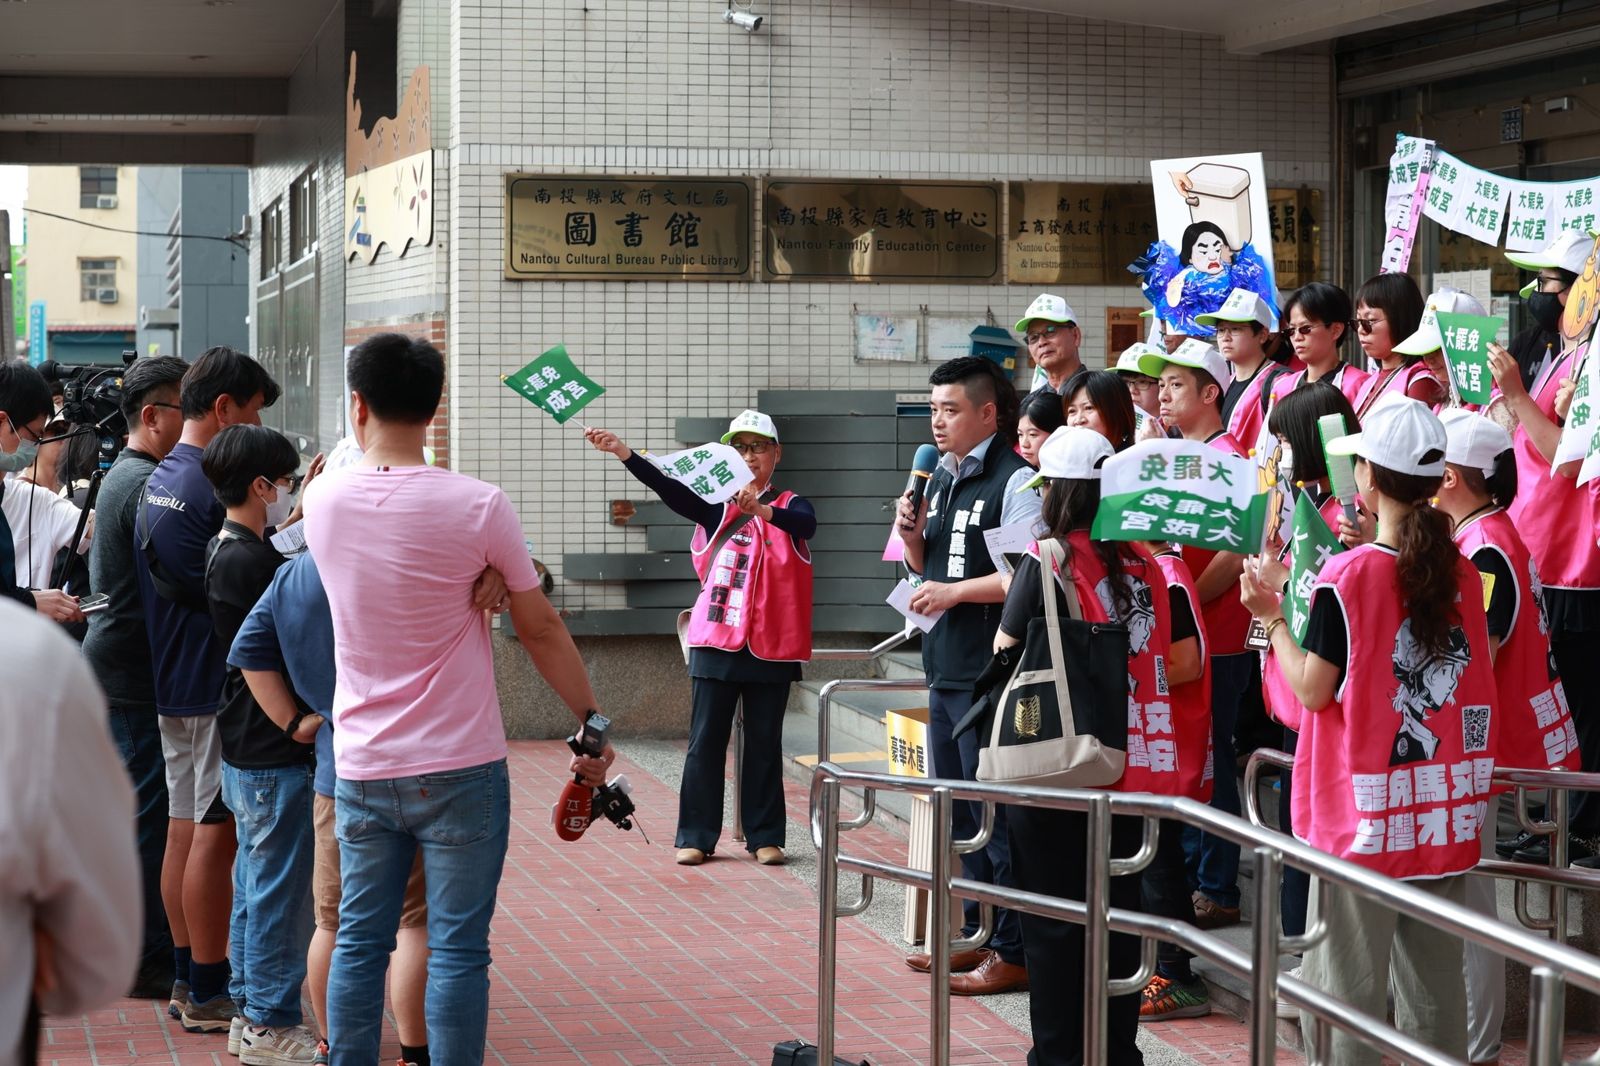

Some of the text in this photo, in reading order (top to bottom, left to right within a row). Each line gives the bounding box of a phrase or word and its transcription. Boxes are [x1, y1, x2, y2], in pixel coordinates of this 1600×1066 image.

[1432, 159, 1458, 184] 大罷免
[534, 187, 729, 206] 南投縣政府文化局
[1476, 179, 1500, 202] 大罷免
[1518, 190, 1544, 210] 大罷免
[1565, 188, 1592, 208] 大罷免
[776, 206, 988, 229] 南投縣家庭教育中心
[1465, 202, 1499, 232] 大成宮
[1510, 216, 1546, 240] 大成宮
[565, 211, 702, 249] 圖書館
[777, 239, 987, 252] Nantou Family Education Center
[1016, 242, 1043, 253] Nantou
[520, 253, 740, 268] Nantou Cultural Bureau Public Library
[1444, 326, 1480, 352] 大罷免
[1450, 362, 1482, 393] 成宮
